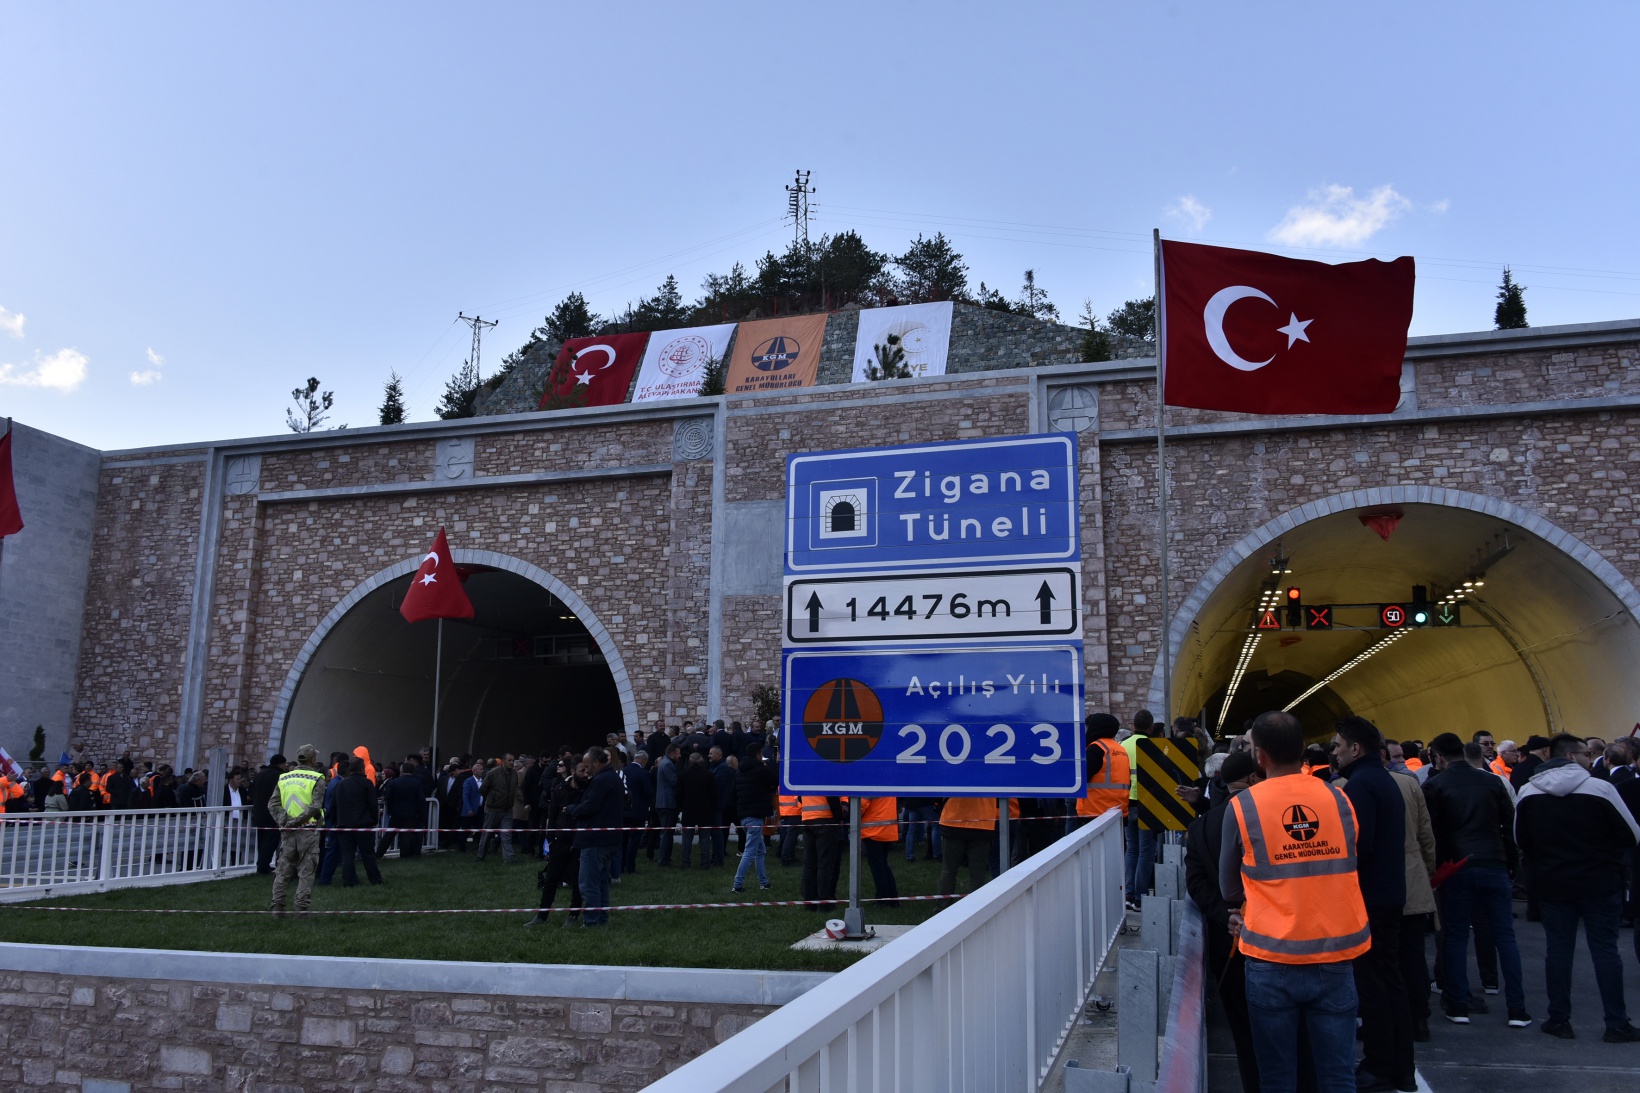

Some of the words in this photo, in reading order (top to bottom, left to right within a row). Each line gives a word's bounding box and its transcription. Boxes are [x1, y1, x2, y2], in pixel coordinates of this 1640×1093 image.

[762, 353, 787, 361] KGM
[745, 373, 796, 383] KARAYOLLARI
[735, 384, 756, 392] GENEL
[638, 390, 670, 400] ALTYAPI
[893, 468, 1050, 503] Zigana
[899, 506, 1047, 542] Tüneli
[845, 592, 1011, 622] 14476m
[1387, 611, 1400, 621] 50
[905, 675, 995, 699] Açılış
[1007, 673, 1060, 695] Yılı
[821, 721, 864, 736] KGM
[896, 723, 1062, 765] 2023
[1283, 841, 1329, 851] KARAYOLLARI
[1274, 852, 1297, 861] GENEL
